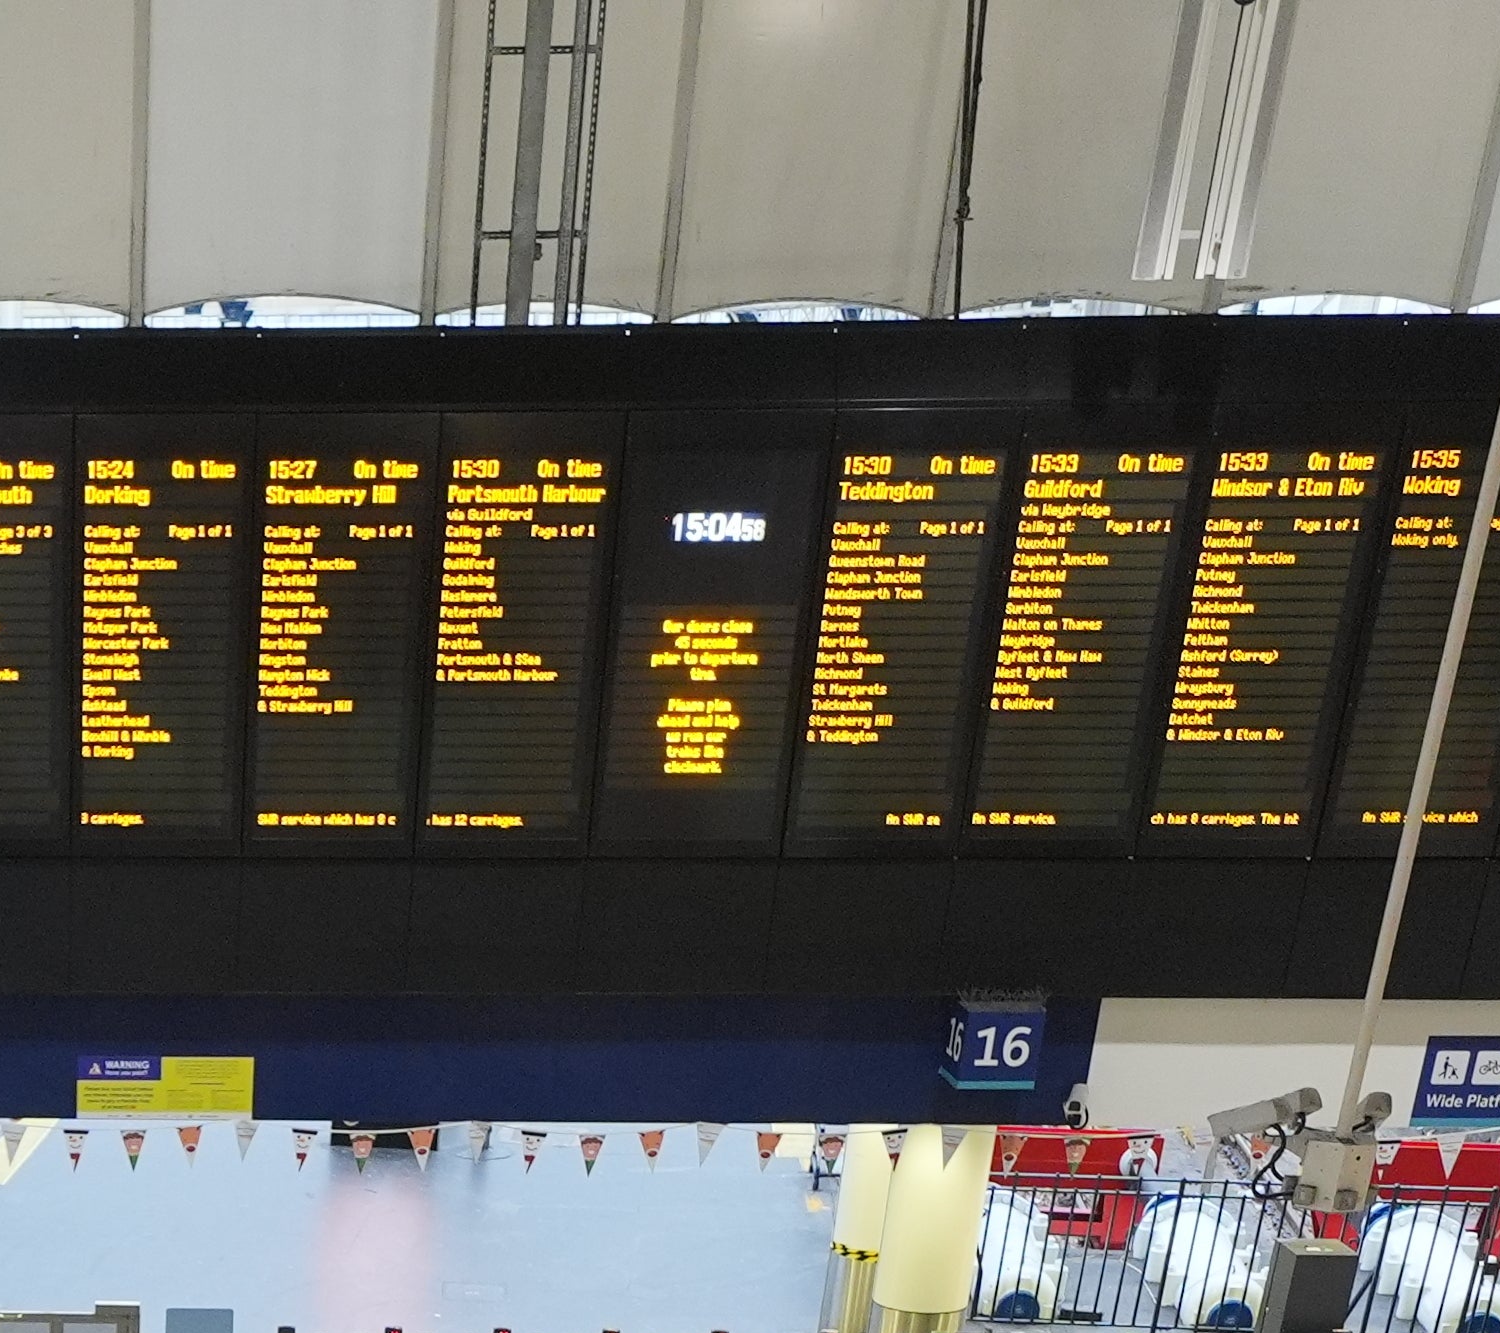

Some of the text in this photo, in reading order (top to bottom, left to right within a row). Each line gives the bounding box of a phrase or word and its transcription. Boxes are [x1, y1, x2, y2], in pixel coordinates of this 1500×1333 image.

[453, 459, 602, 478] 15:30 On time
[845, 456, 995, 475] 15:30 On time
[1031, 454, 1184, 473] 15:33 On time
[1221, 452, 1374, 471] 15:33 On time
[1412, 450, 1461, 468] 15:35
[18, 461, 54, 479] time
[88, 460, 236, 479] 15:24 On time
[270, 460, 418, 479] 15:27 On time
[85, 485, 150, 506] Dorking
[266, 485, 396, 504] Strawberry Hill
[448, 484, 606, 503] Portsmouth Harbour
[840, 482, 934, 502] Teddington
[1025, 480, 1103, 498] Guildford
[1212, 478, 1364, 496] Windsor & Eton Riv
[1403, 476, 1461, 496] Woking
[1014, 553, 1057, 568] Clapham
[945, 1017, 965, 1060] 16
[973, 1025, 1032, 1067] 16
[104, 1060, 150, 1069] WARNING
[1426, 1094, 1464, 1109] Wide
